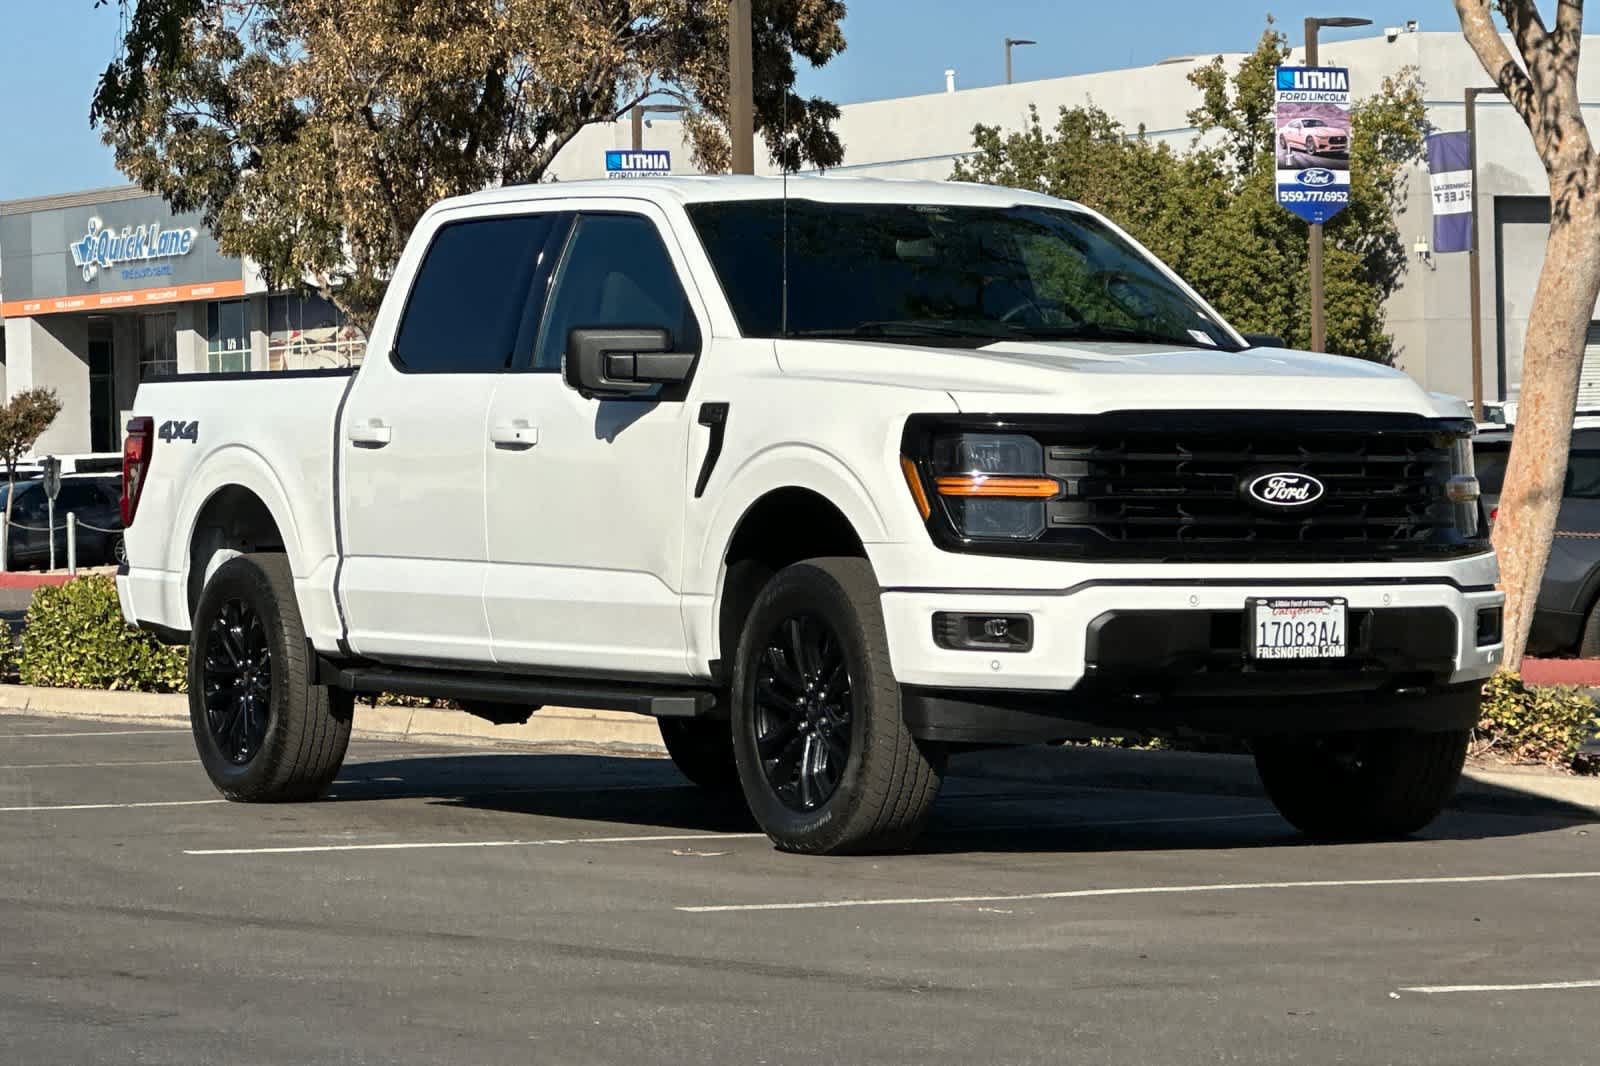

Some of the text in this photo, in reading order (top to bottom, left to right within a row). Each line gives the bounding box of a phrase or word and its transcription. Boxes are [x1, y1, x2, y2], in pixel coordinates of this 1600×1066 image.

[1294, 71, 1347, 90] LITHIA
[1280, 92, 1347, 102] FORD LINCOLN
[621, 153, 669, 169] LITHIA
[1303, 169, 1330, 184] Ford
[1280, 190, 1348, 202] 559.777.6952
[97, 224, 194, 267] Quick Lane
[1263, 476, 1310, 500] Ford
[1260, 620, 1341, 647] 17083A4
[1256, 646, 1345, 659] FRESNOFORD.COM
